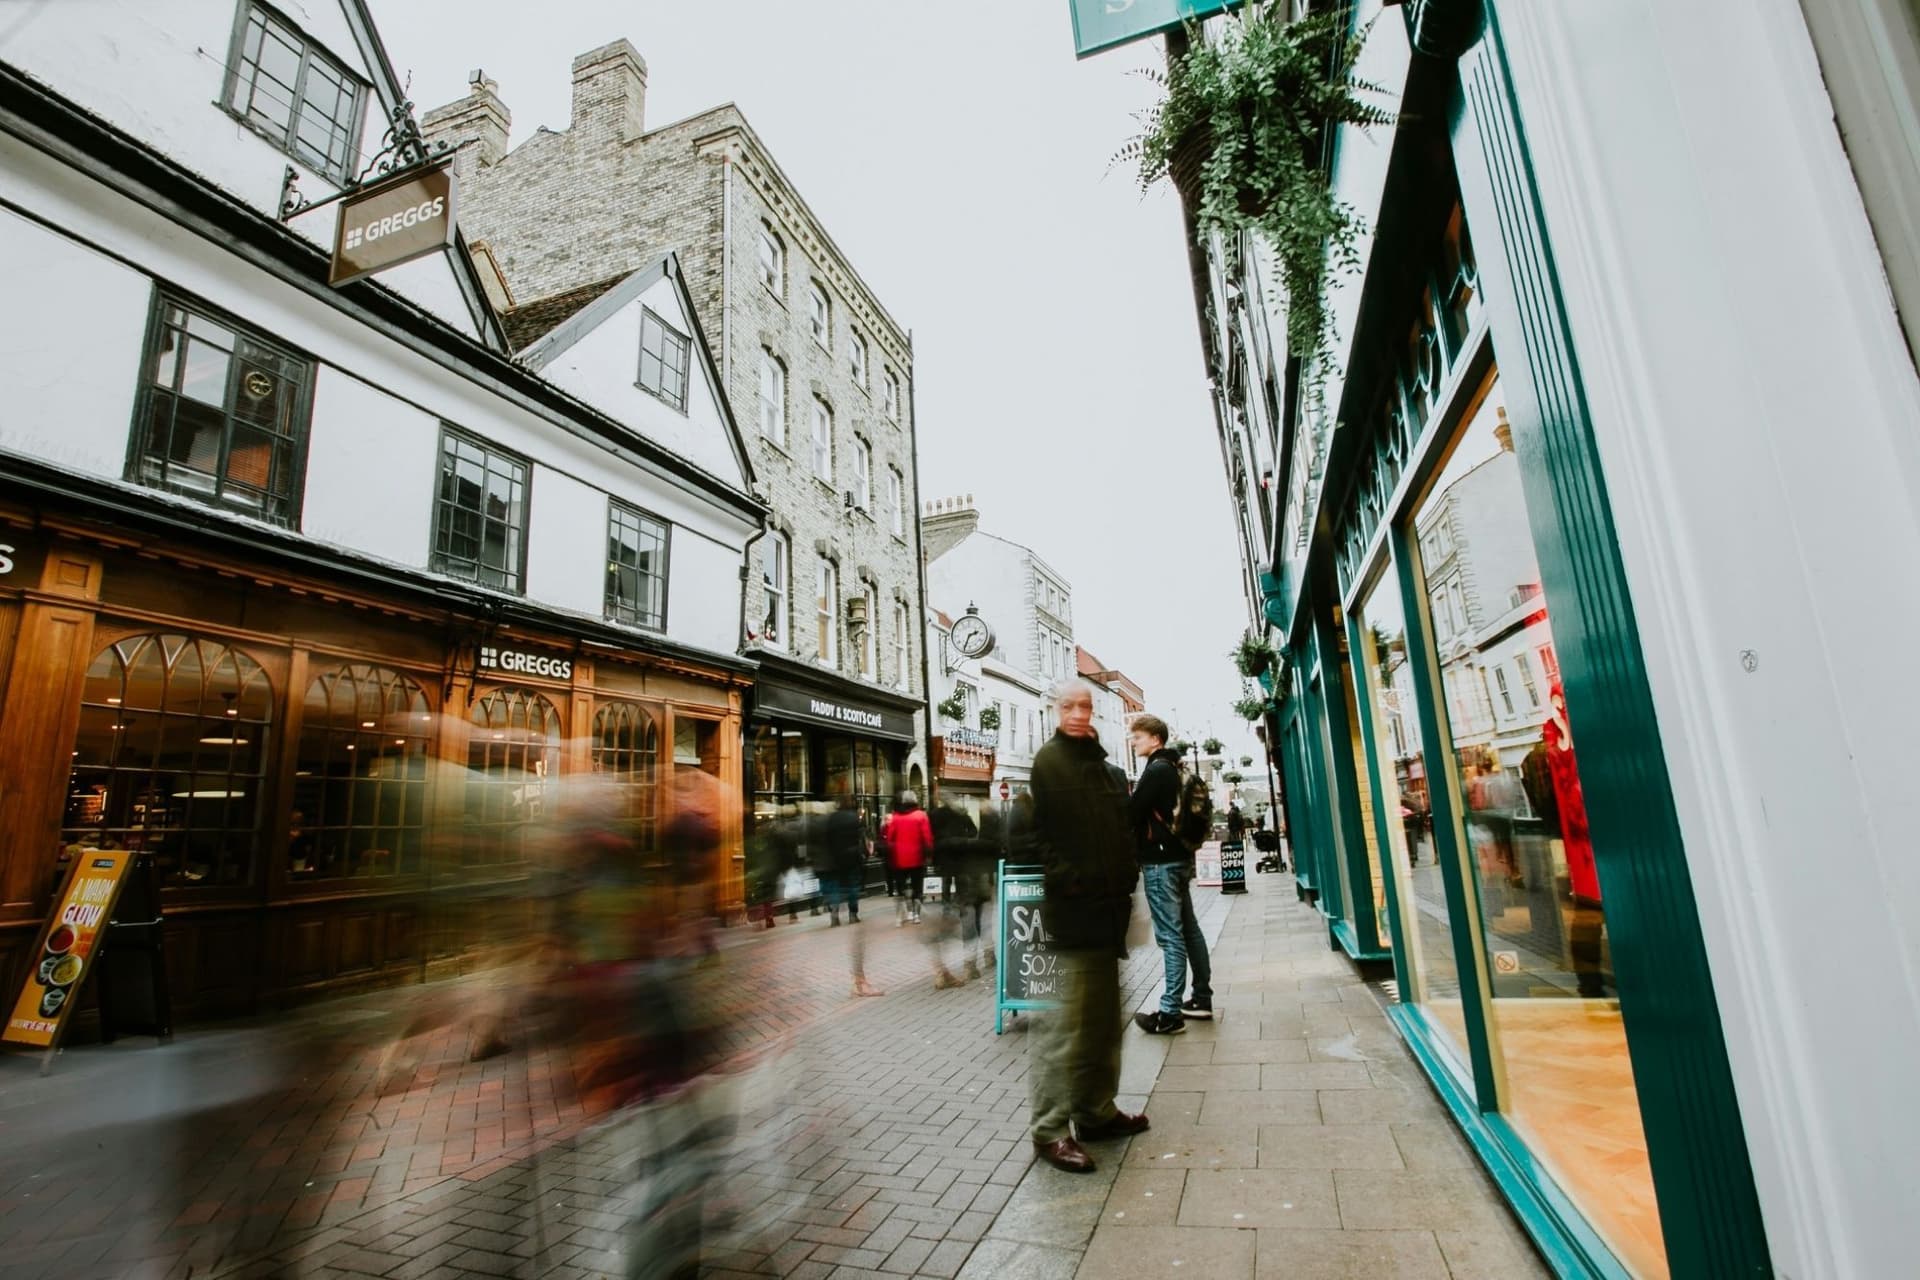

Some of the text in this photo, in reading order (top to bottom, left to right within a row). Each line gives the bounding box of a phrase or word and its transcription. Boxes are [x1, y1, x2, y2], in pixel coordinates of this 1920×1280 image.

[365, 196, 444, 241] GREGGS
[500, 650, 572, 679] GREGGS
[810, 699, 836, 718] PADDY
[836, 706, 842, 720] &
[843, 707, 867, 725] SCOTT'S
[1221, 850, 1243, 860] SHOP
[1222, 859, 1243, 868] OPEN
[71, 878, 84, 901] A
[62, 902, 105, 928] GLOW
[1019, 954, 1057, 977] 50%
[1030, 976, 1057, 994] NOW!
